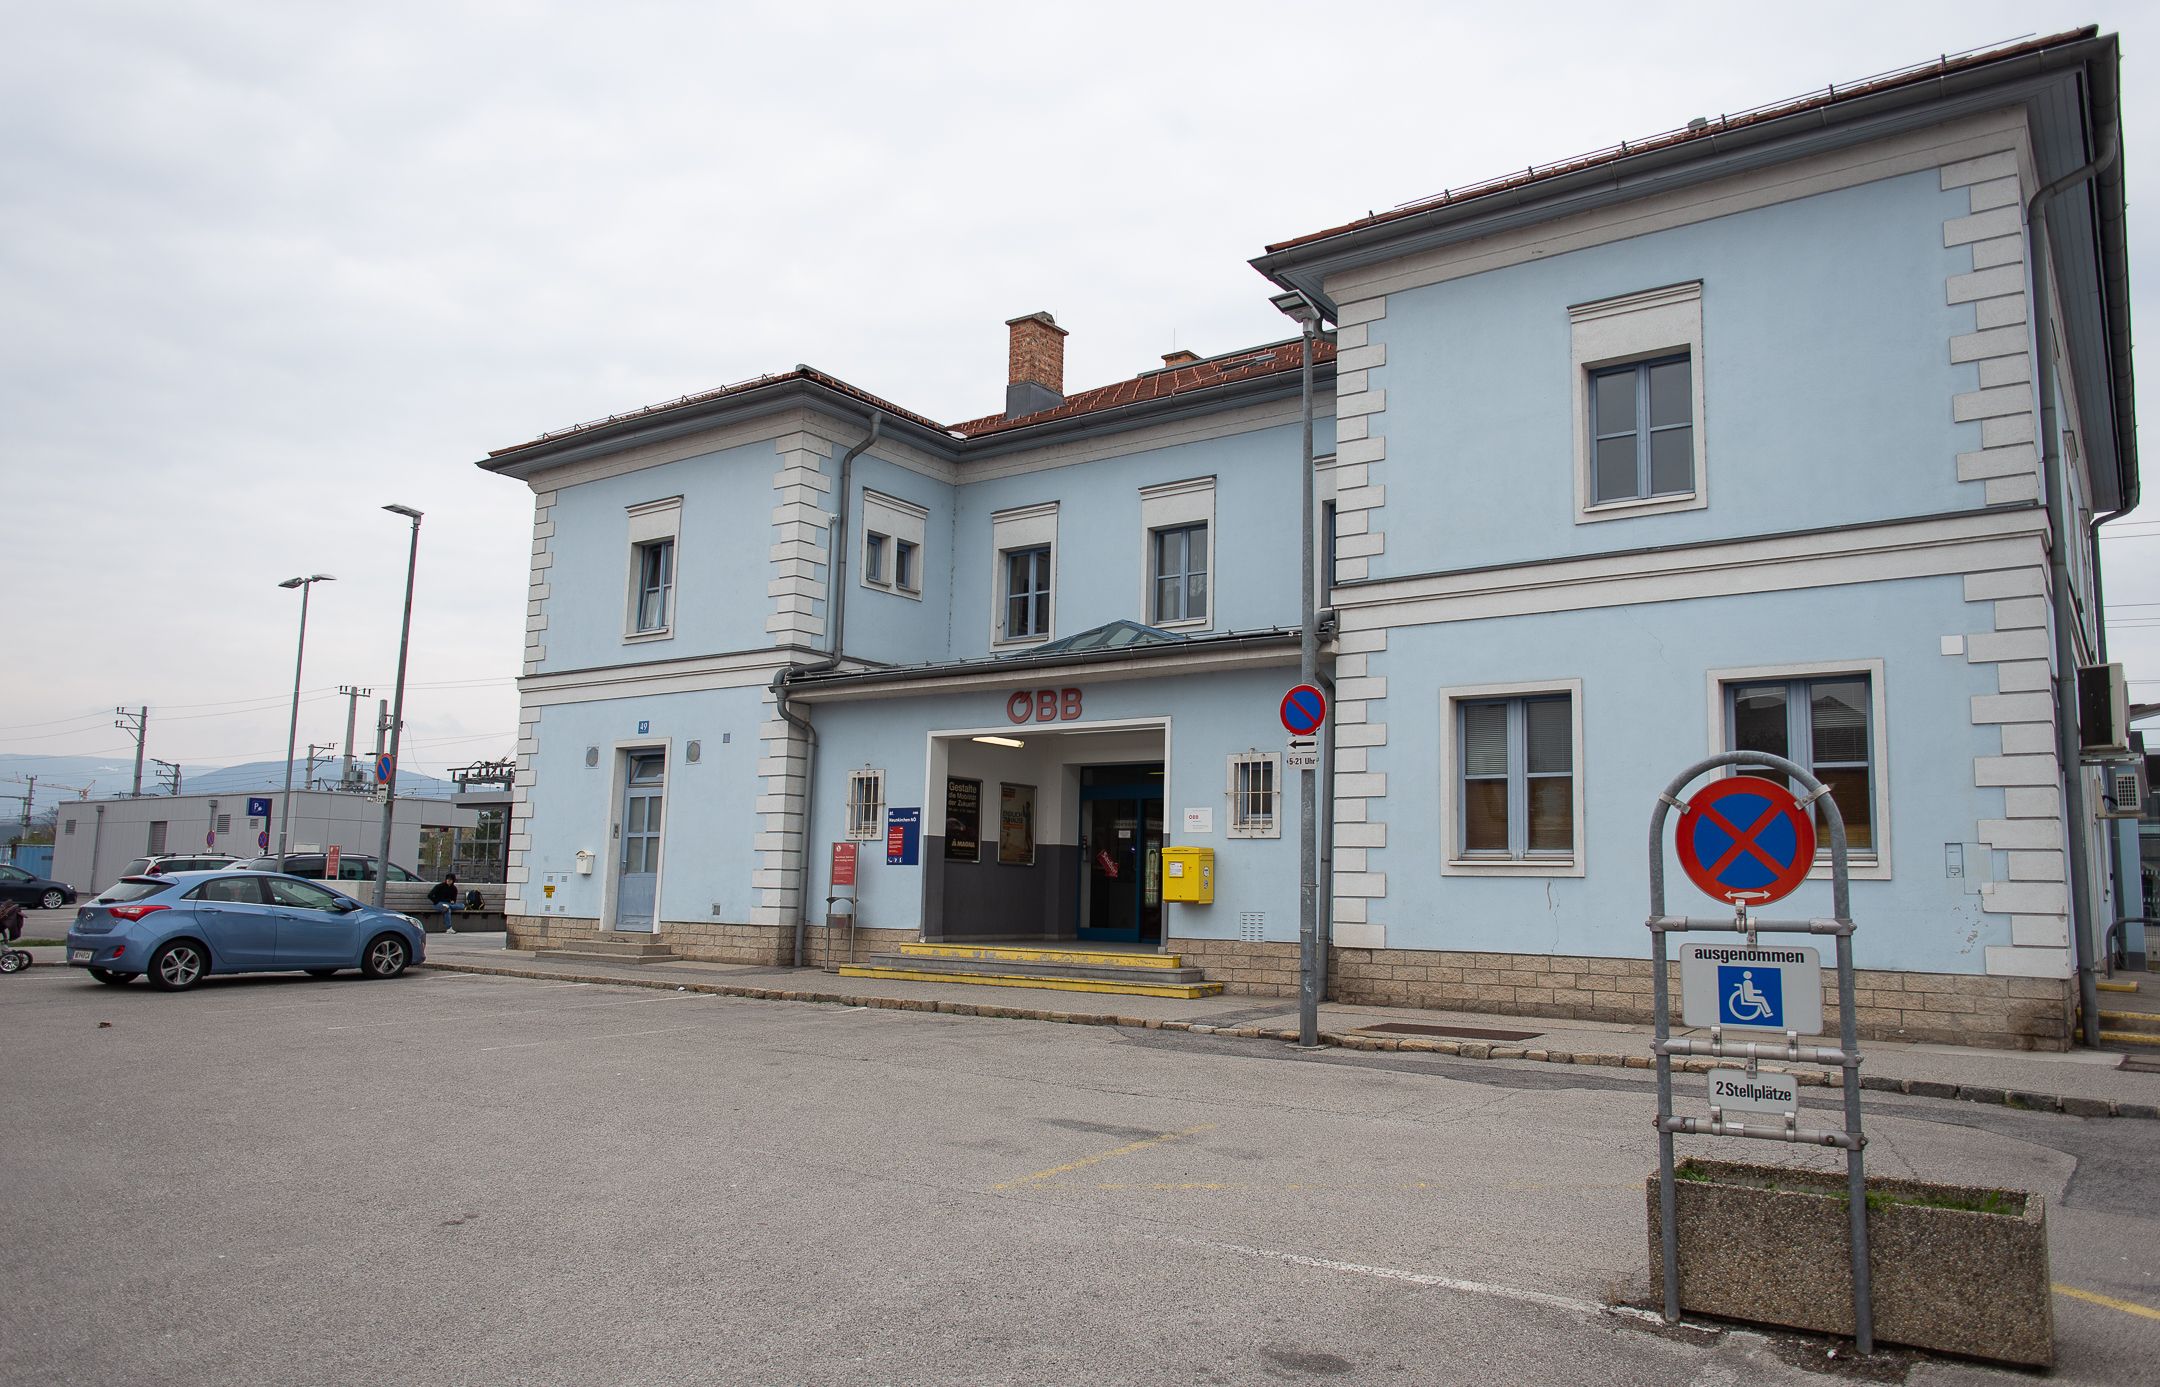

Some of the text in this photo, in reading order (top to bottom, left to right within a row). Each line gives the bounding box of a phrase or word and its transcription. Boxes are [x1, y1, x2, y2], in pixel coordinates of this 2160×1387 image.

[1007, 688, 1082, 724] ÖBB
[640, 722, 648, 730] 49
[1304, 757, 1316, 765] Uhr
[948, 781, 977, 794] Gestalte
[1695, 948, 1805, 964] ausgenommen
